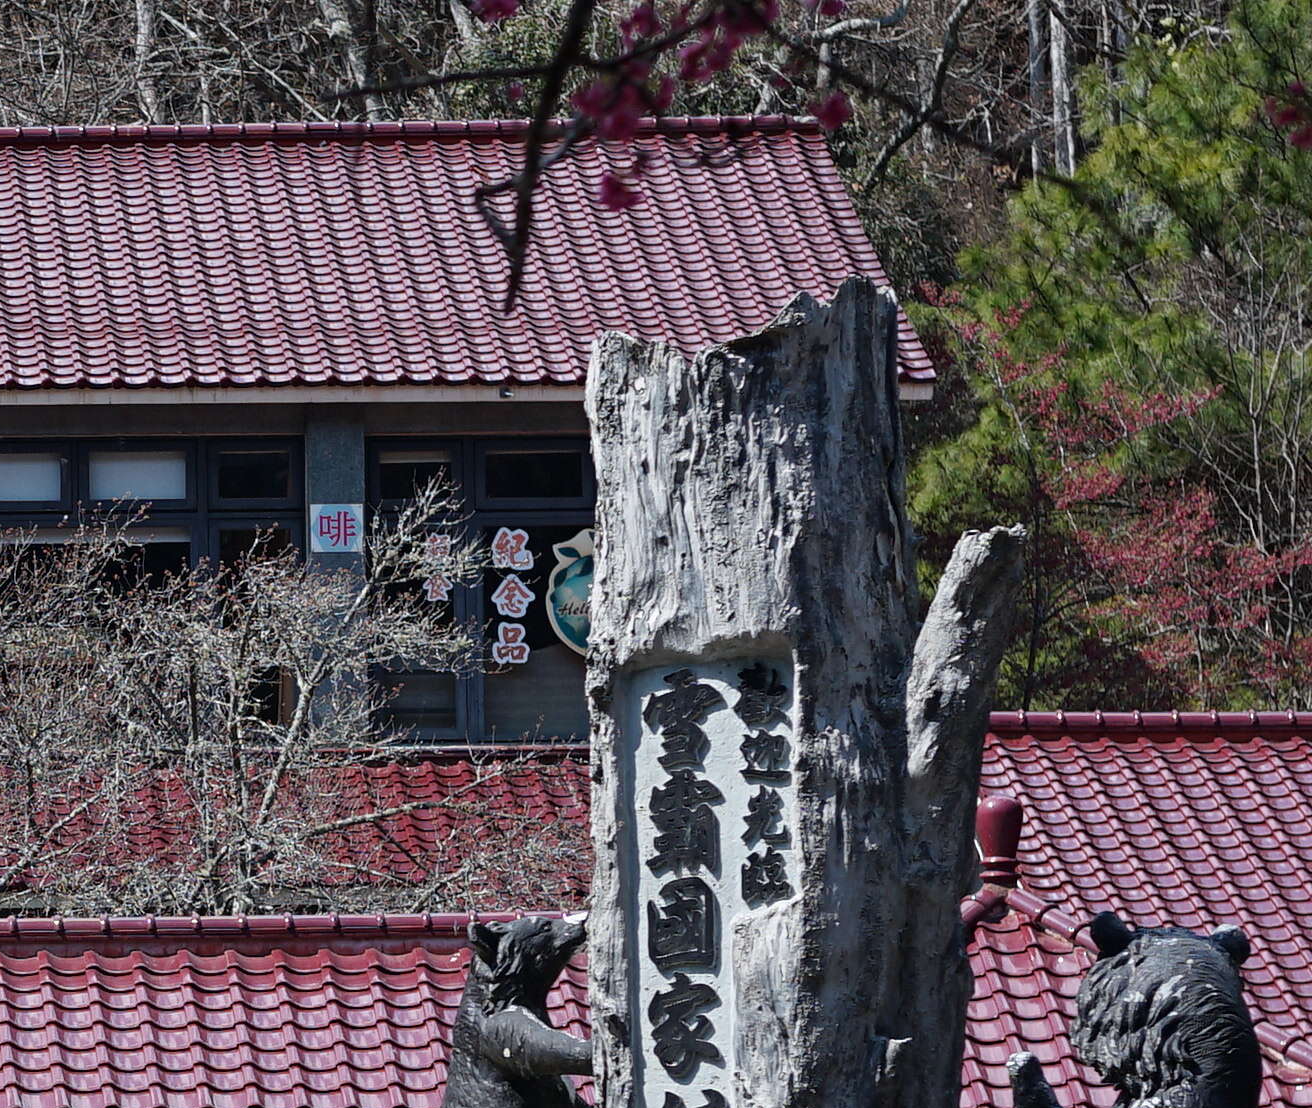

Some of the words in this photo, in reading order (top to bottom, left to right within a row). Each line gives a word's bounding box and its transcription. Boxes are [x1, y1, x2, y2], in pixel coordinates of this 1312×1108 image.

[319, 511, 356, 547] 啡
[492, 527, 535, 664] 紀念品
